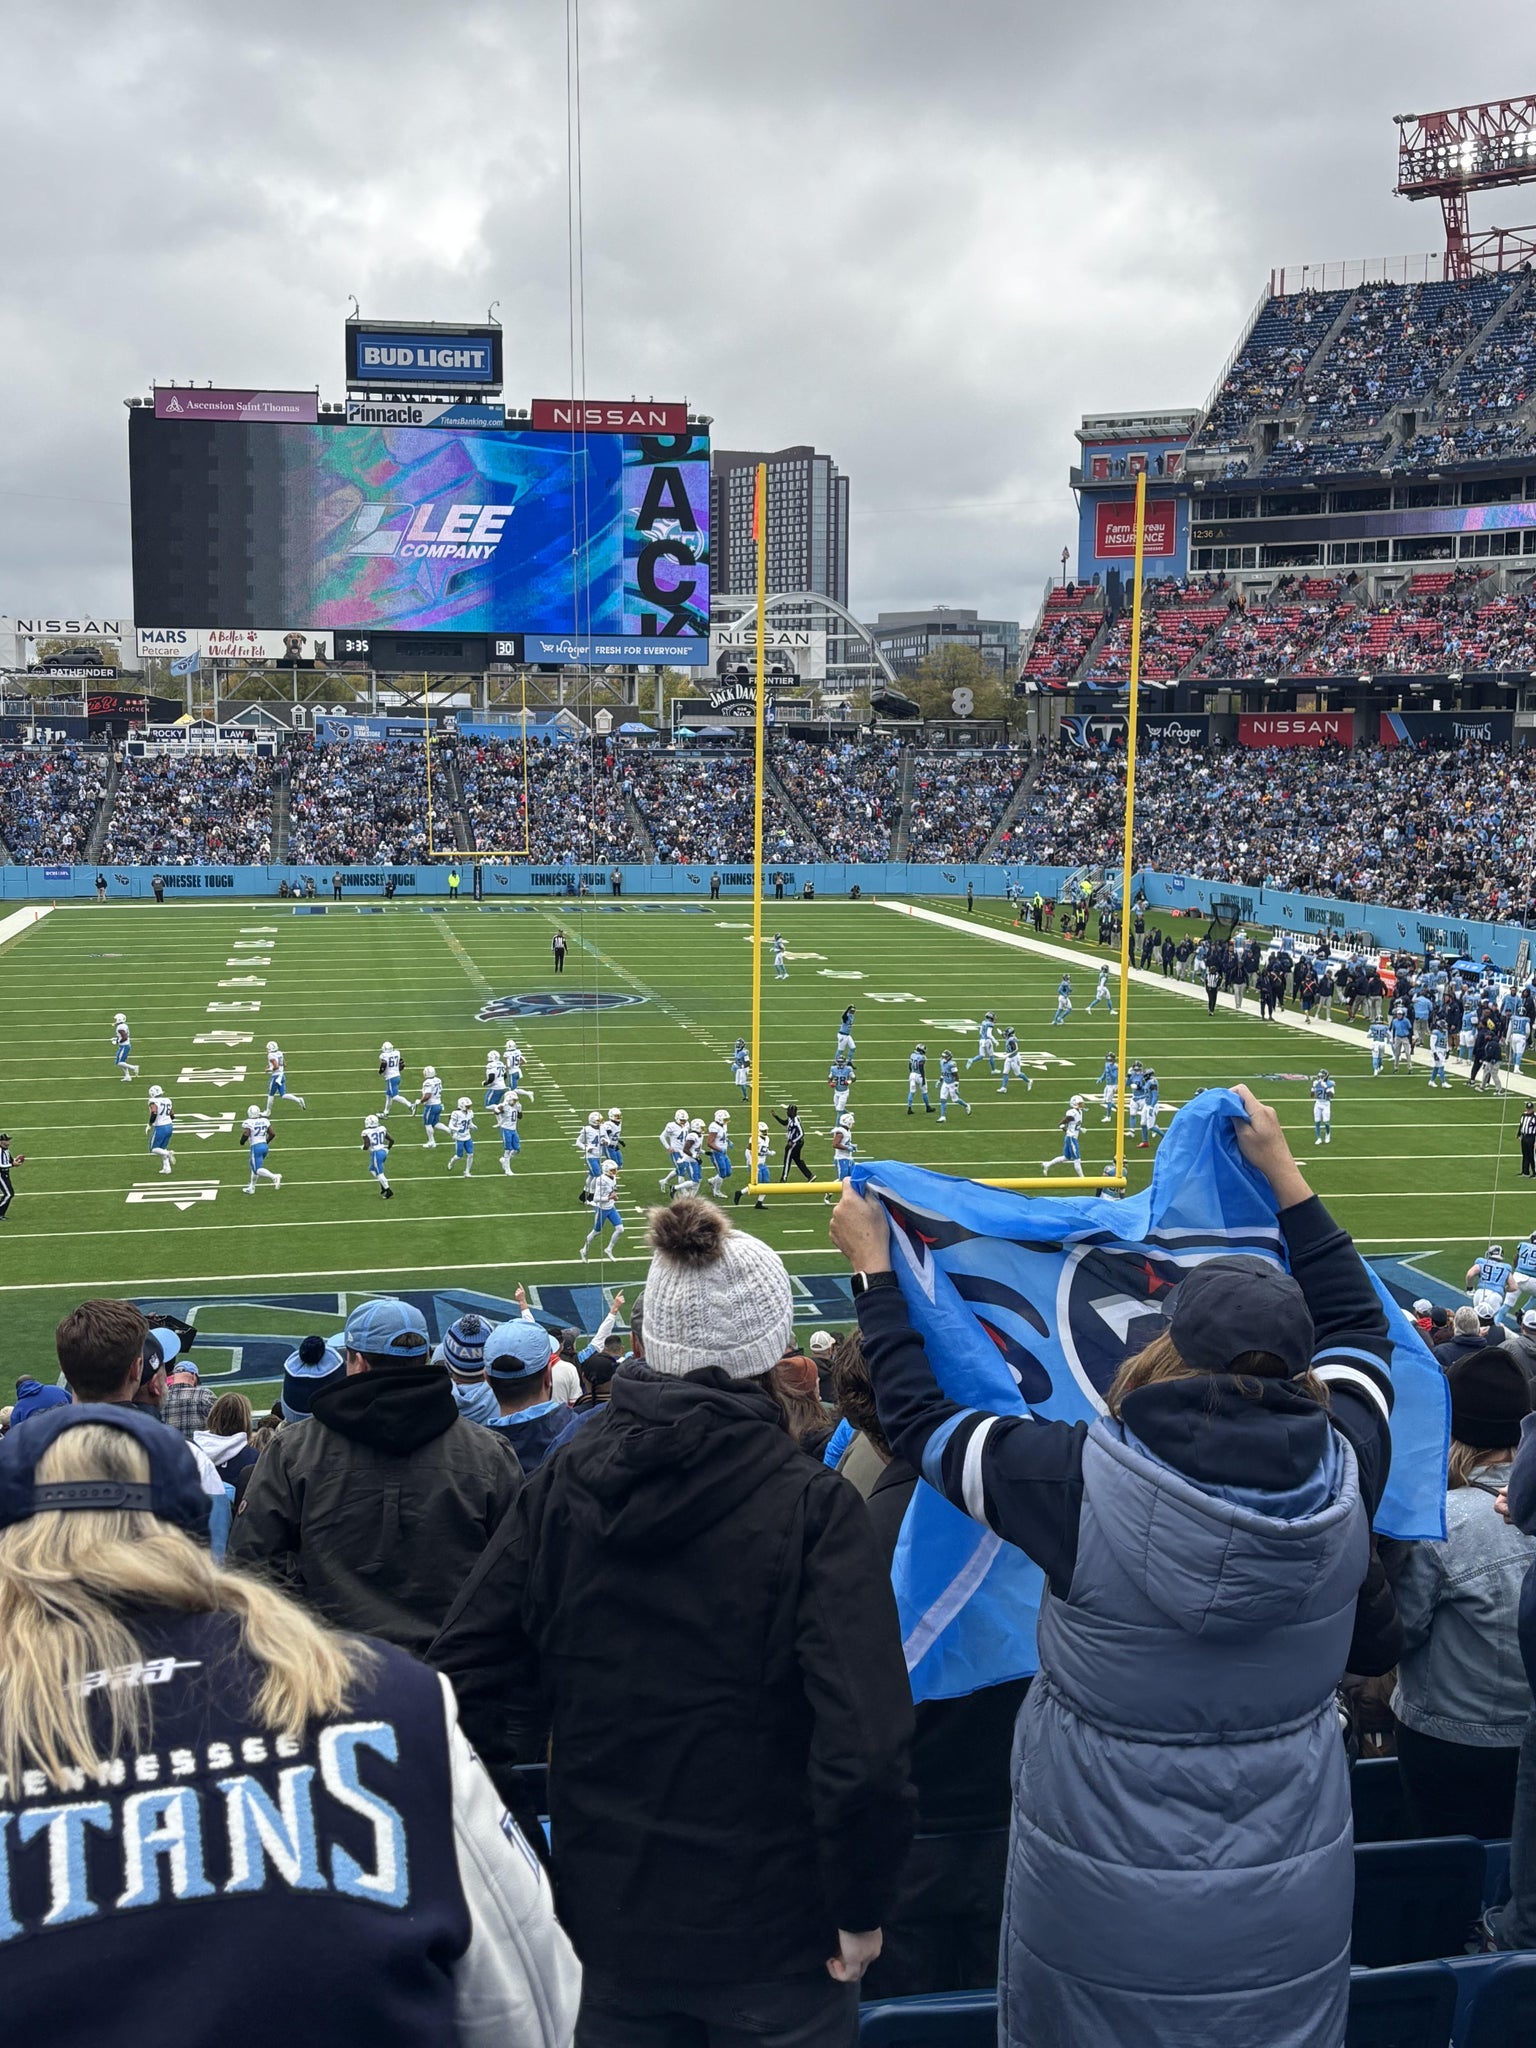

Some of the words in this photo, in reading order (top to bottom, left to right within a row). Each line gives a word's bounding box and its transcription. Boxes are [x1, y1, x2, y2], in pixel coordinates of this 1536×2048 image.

[364, 347, 414, 366] BUD
[418, 349, 485, 368] LIGHT
[187, 400, 234, 411] Ascension
[236, 402, 261, 411] Saint
[263, 402, 300, 413] Thomas
[349, 404, 422, 424] Pinnacle
[553, 408, 667, 426] NISSAN
[440, 416, 503, 427] TitansBanking.com
[406, 504, 515, 542] LEE
[1106, 524, 1130, 533] Farm
[1133, 523, 1166, 532] Breau
[1105, 532, 1165, 544] INSURNCE
[400, 543, 497, 559] COMPANY
[17, 620, 119, 633] NISSAN
[141, 630, 187, 643] MARS
[209, 631, 217, 642] A
[718, 631, 809, 645] NISSAN
[142, 646, 180, 655] Petcare
[499, 642, 512, 654] 30
[556, 639, 590, 660] Kroger
[595, 646, 622, 655] FRESH
[624, 646, 641, 655] FOR
[50, 668, 114, 677] PATHFINDER
[710, 687, 735, 709] JACK
[735, 683, 775, 708] DANL'S
[1163, 721, 1202, 744] Kroger
[1254, 720, 1339, 733] NISSAN
[1452, 721, 1491, 741] TITANS
[152, 729, 183, 738] ROCKY
[224, 730, 244, 738] LAW
[162, 874, 202, 888] NNESSEE
[205, 875, 234, 888] TOUGH
[371, 1132, 385, 1146] 30
[1482, 1264, 1504, 1282] 97
